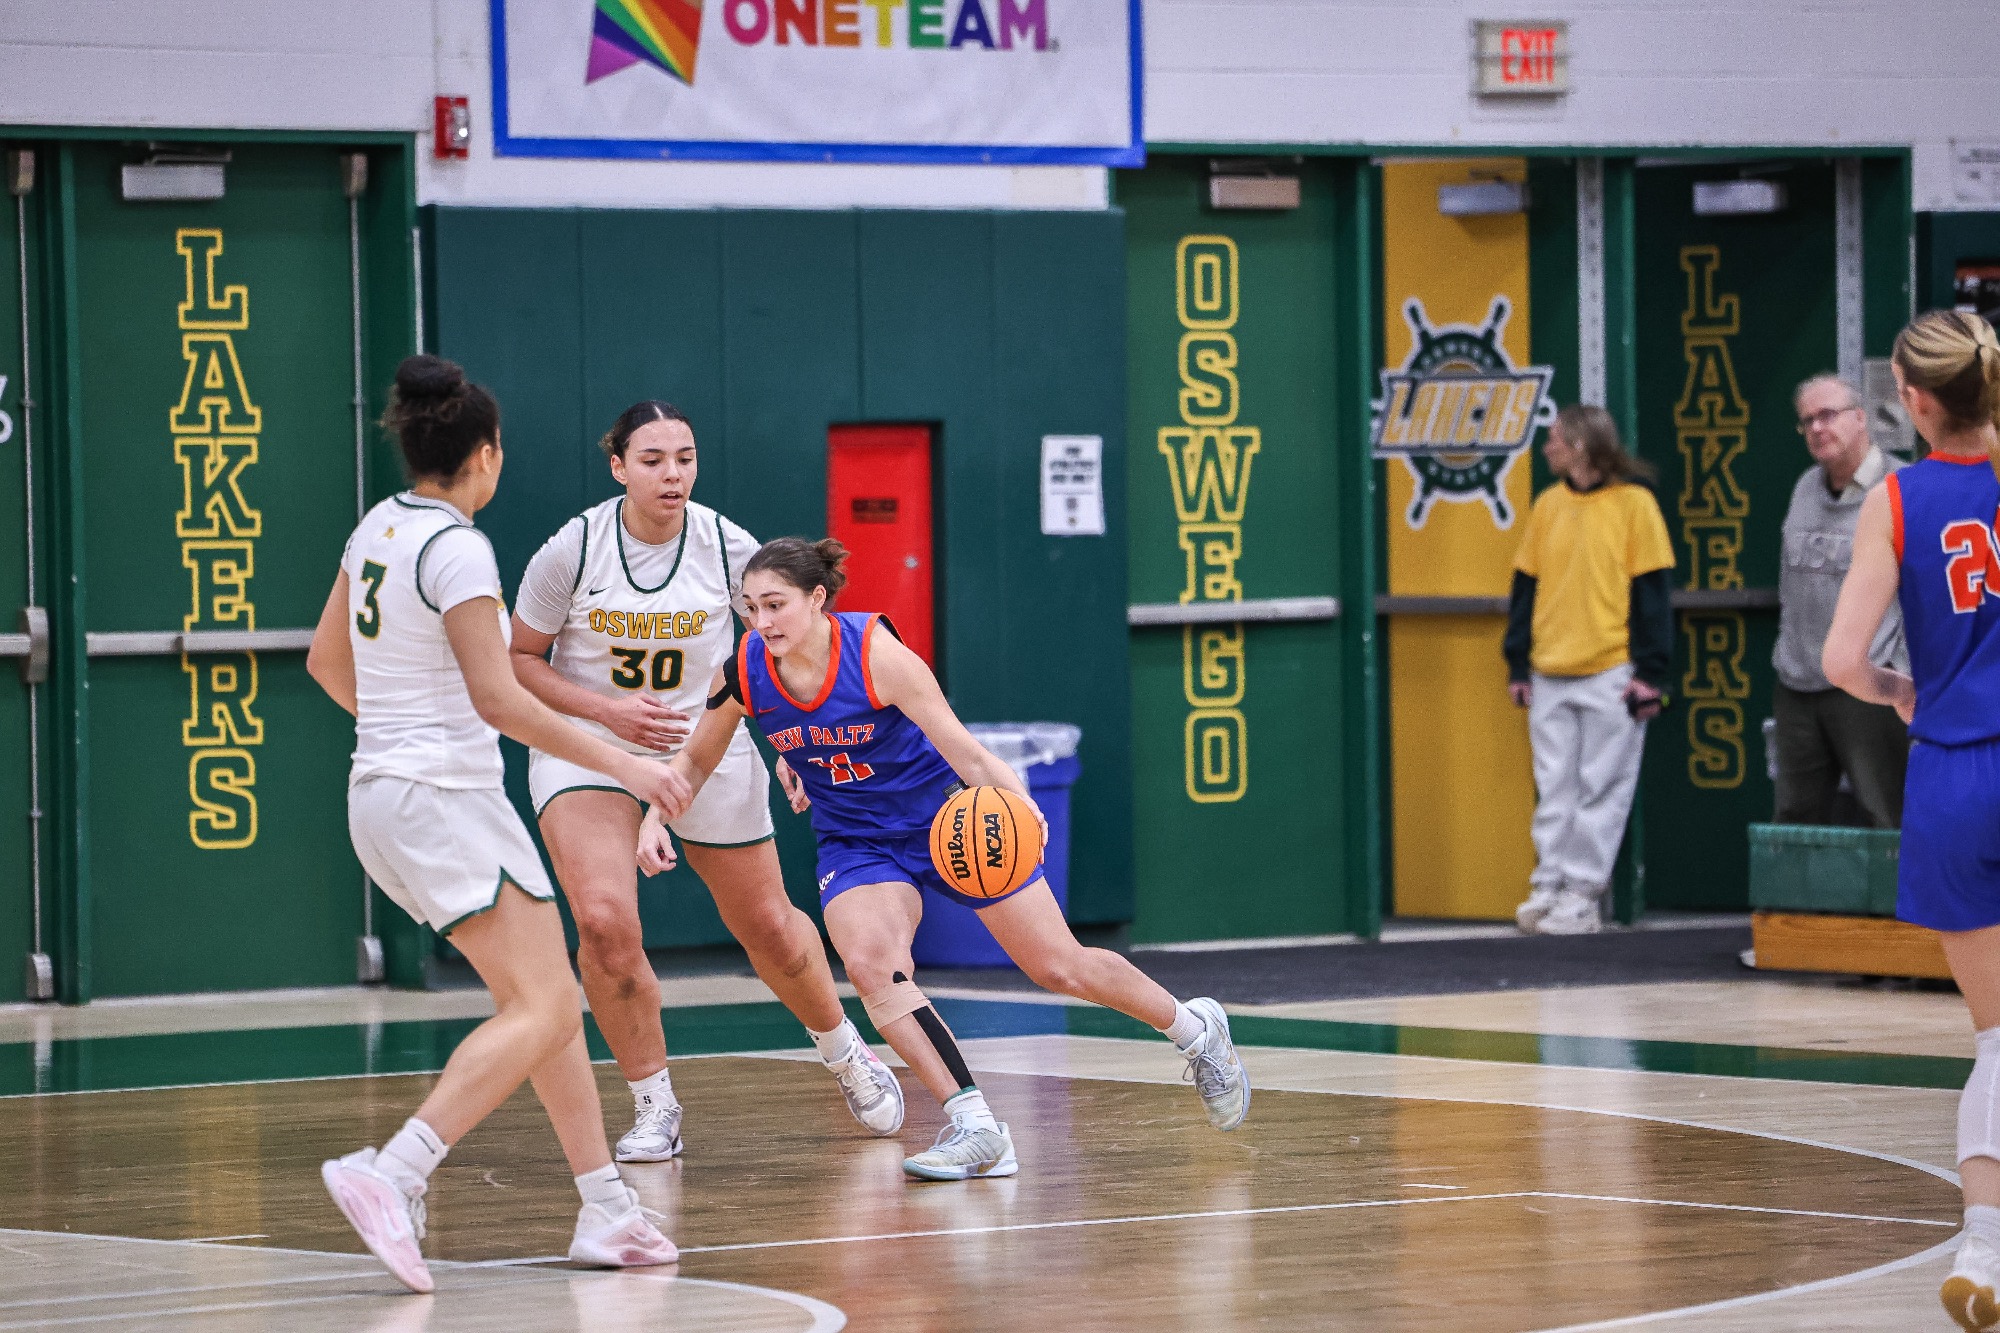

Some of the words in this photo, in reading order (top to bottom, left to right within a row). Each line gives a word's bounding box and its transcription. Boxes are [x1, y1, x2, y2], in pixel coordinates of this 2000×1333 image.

[1501, 28, 1557, 84] EXIT
[169, 228, 264, 850] LAKERS
[1157, 234, 1261, 804] OSWEGO
[1673, 245, 1750, 789] LAKERS
[356, 558, 388, 640] 3
[588, 608, 708, 639] OSWEGO
[609, 645, 685, 691] 30
[808, 723, 875, 746] PALTZ
[807, 752, 876, 786] 11
[947, 806, 971, 880] Wilson
[983, 812, 1003, 869] NCAA
